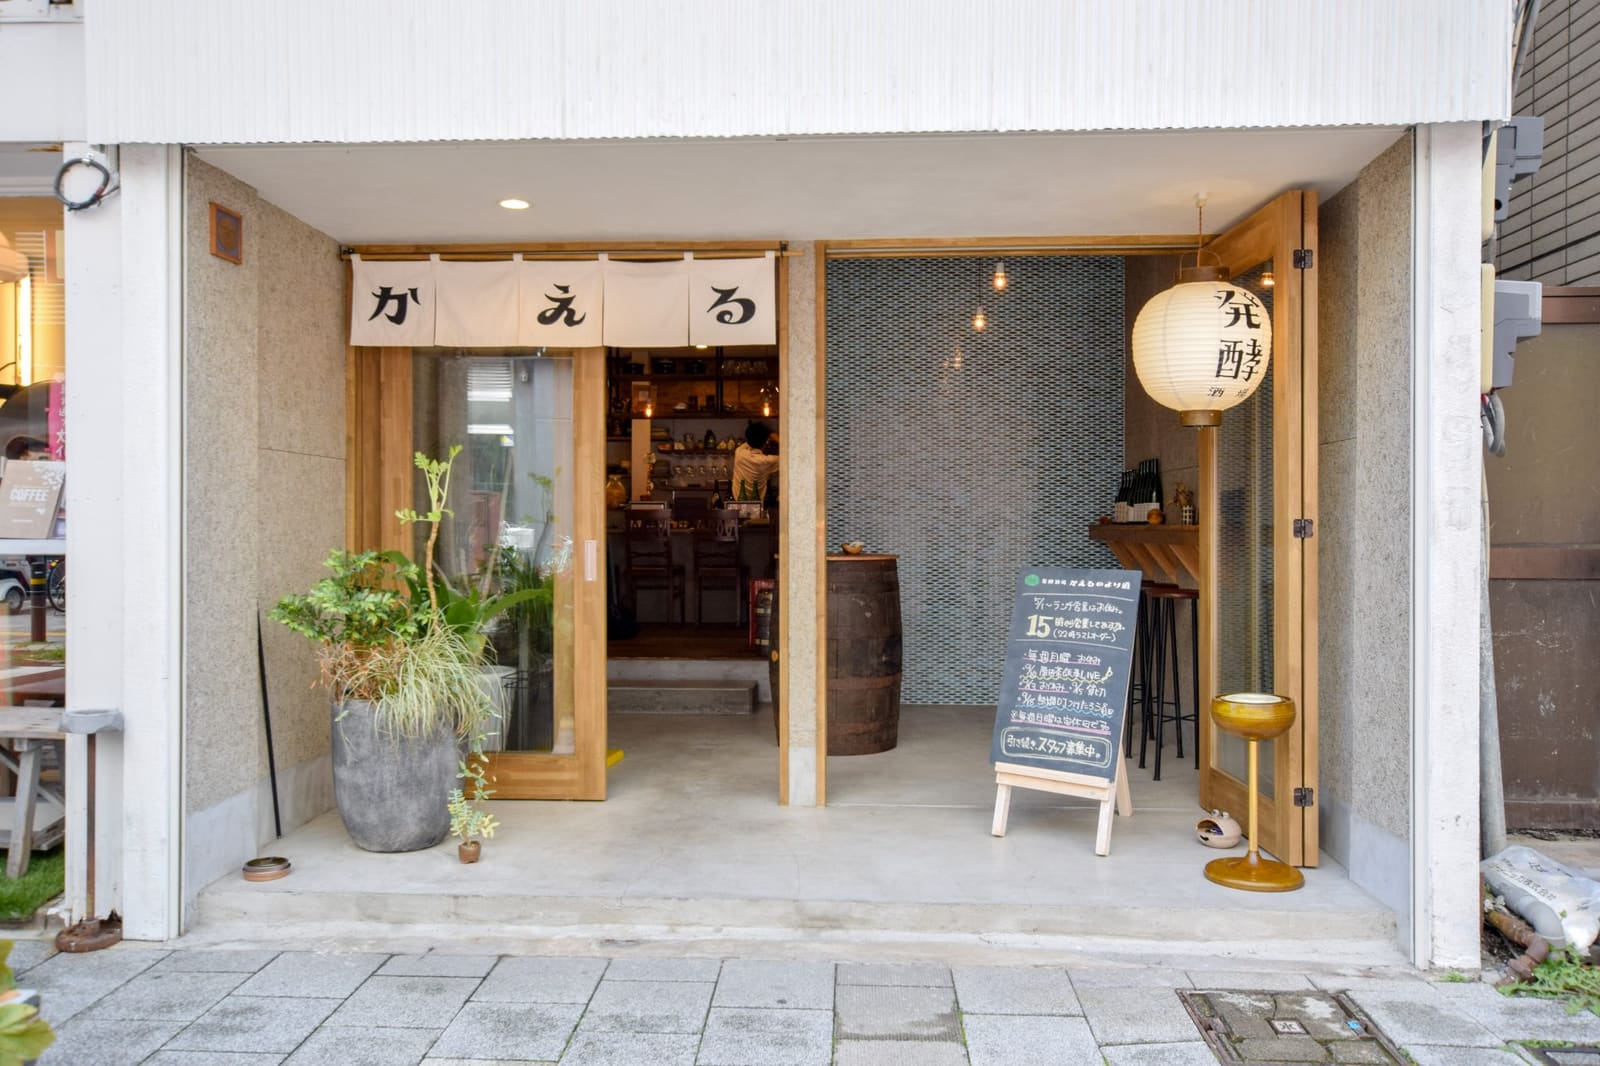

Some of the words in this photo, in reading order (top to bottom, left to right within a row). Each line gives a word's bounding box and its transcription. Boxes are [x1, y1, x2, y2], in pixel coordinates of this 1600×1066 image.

[1213, 290, 1263, 383] 発酵
[9, 487, 49, 502] COFFEE
[1026, 614, 1054, 638] 15
